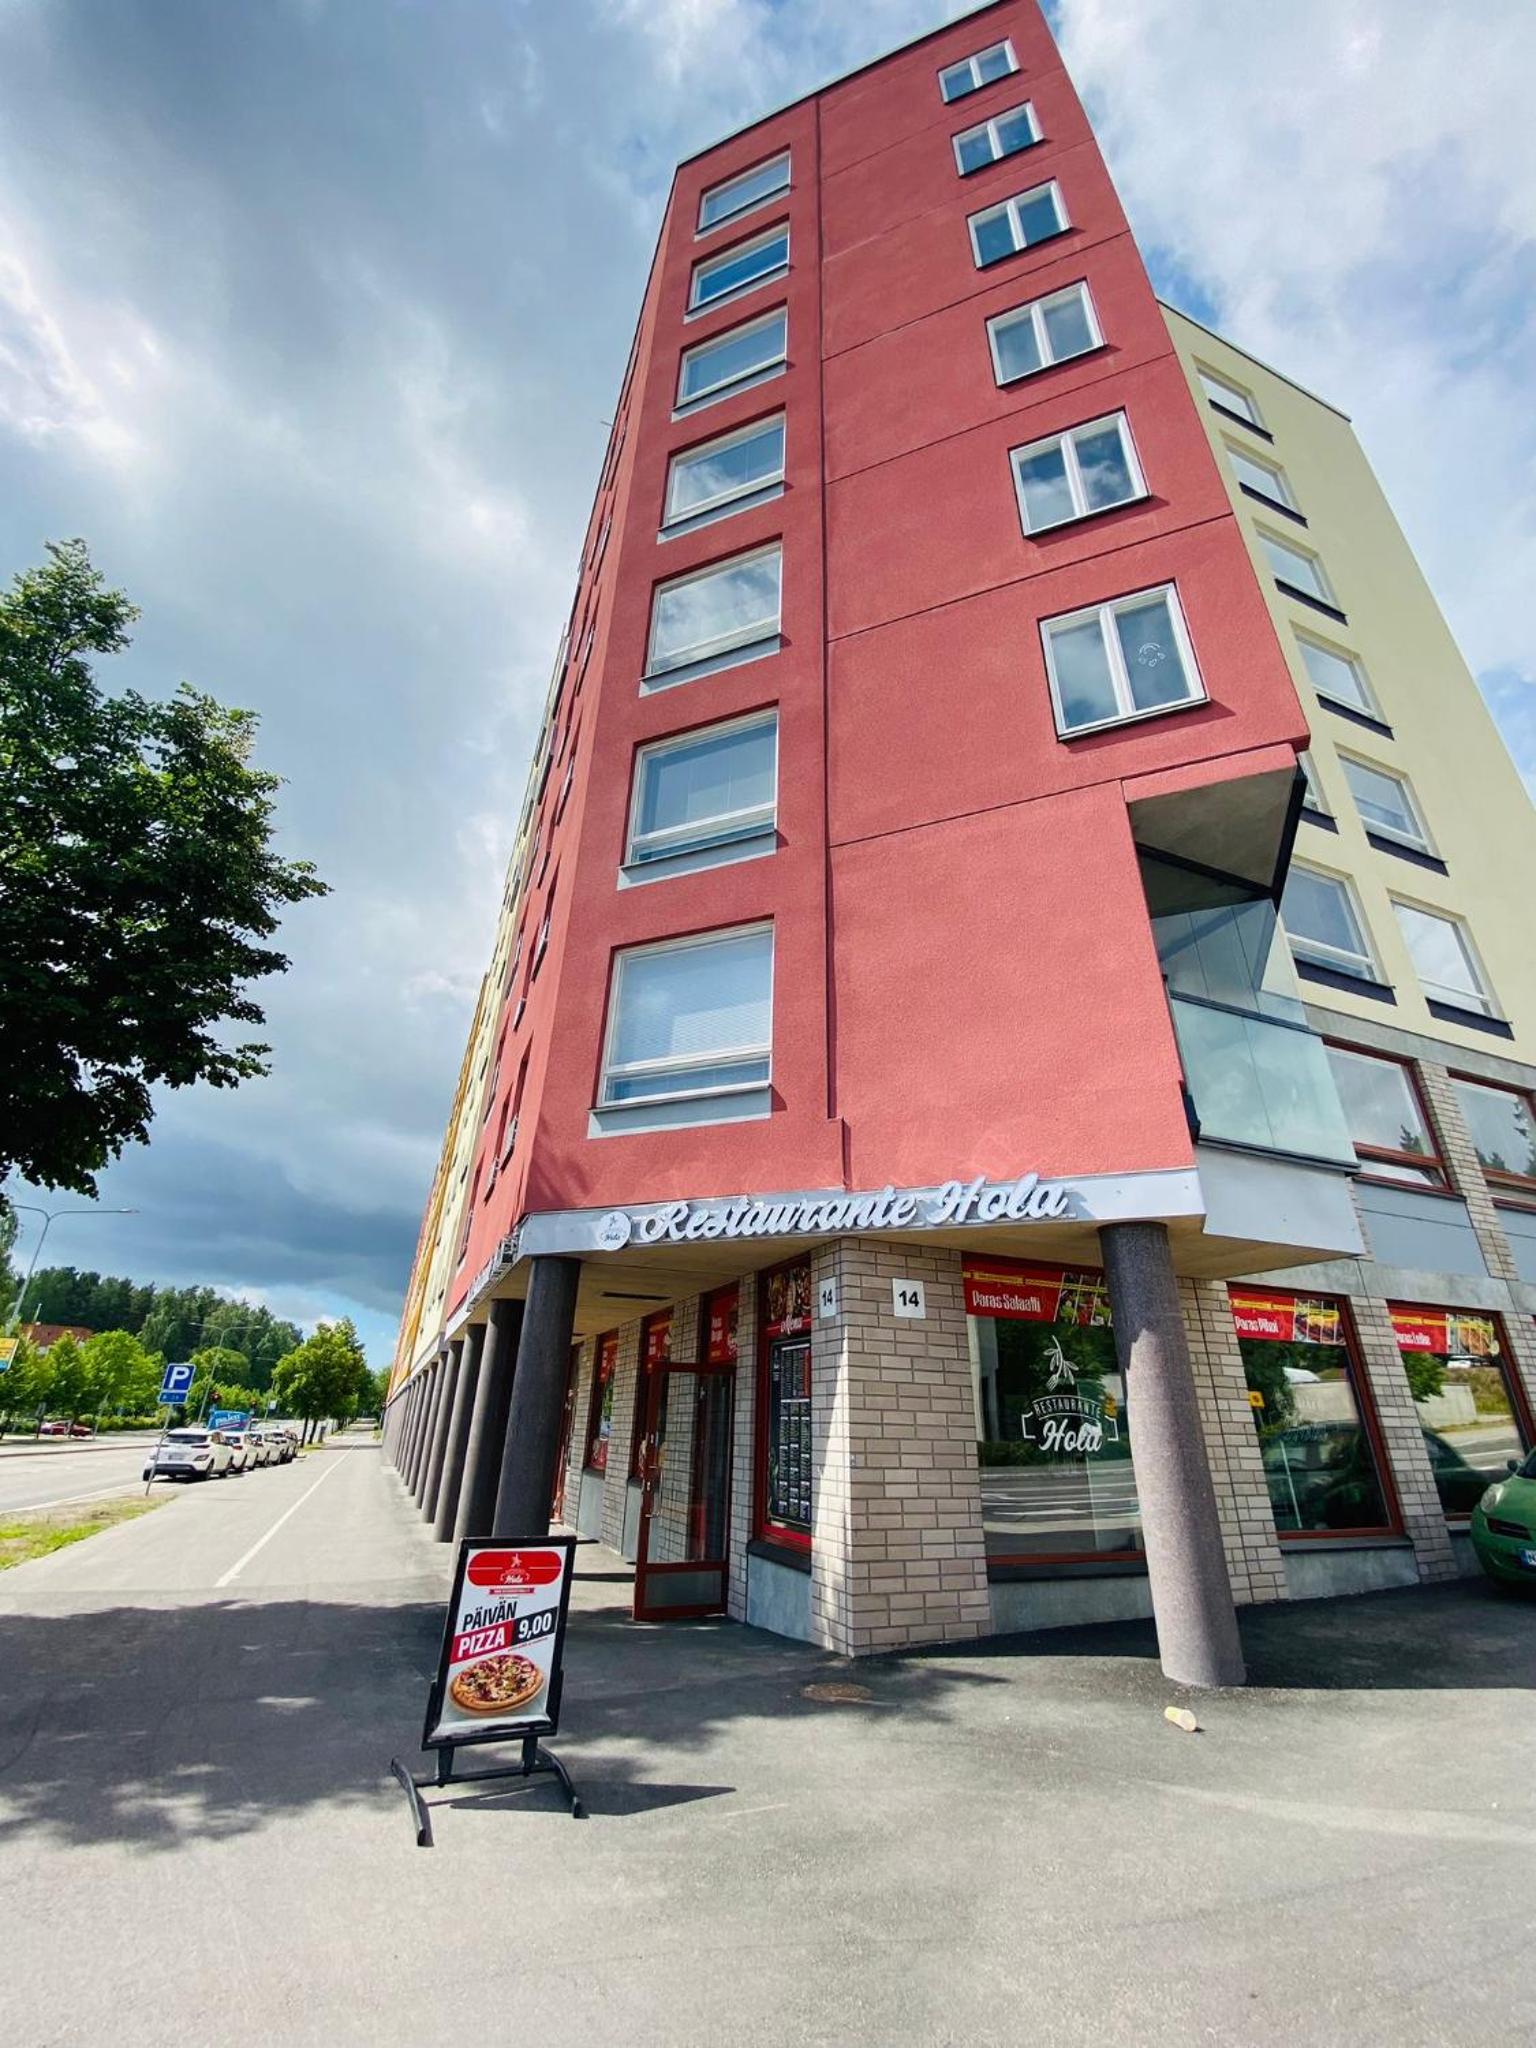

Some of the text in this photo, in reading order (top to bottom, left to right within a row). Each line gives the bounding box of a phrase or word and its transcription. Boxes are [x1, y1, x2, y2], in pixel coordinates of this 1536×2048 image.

[639, 1172, 1069, 1243] Restaurante Hola
[821, 1288, 834, 1307] 14
[898, 1290, 920, 1307] 14
[972, 1290, 1002, 1309] Paras
[168, 1366, 190, 1388] P
[1033, 1398, 1102, 1418] RESTAURANTE
[1038, 1418, 1103, 1452] Hola
[462, 1600, 518, 1633] PÄIVÄN
[518, 1612, 552, 1639] 9,00
[458, 1627, 506, 1658] PIZZA
